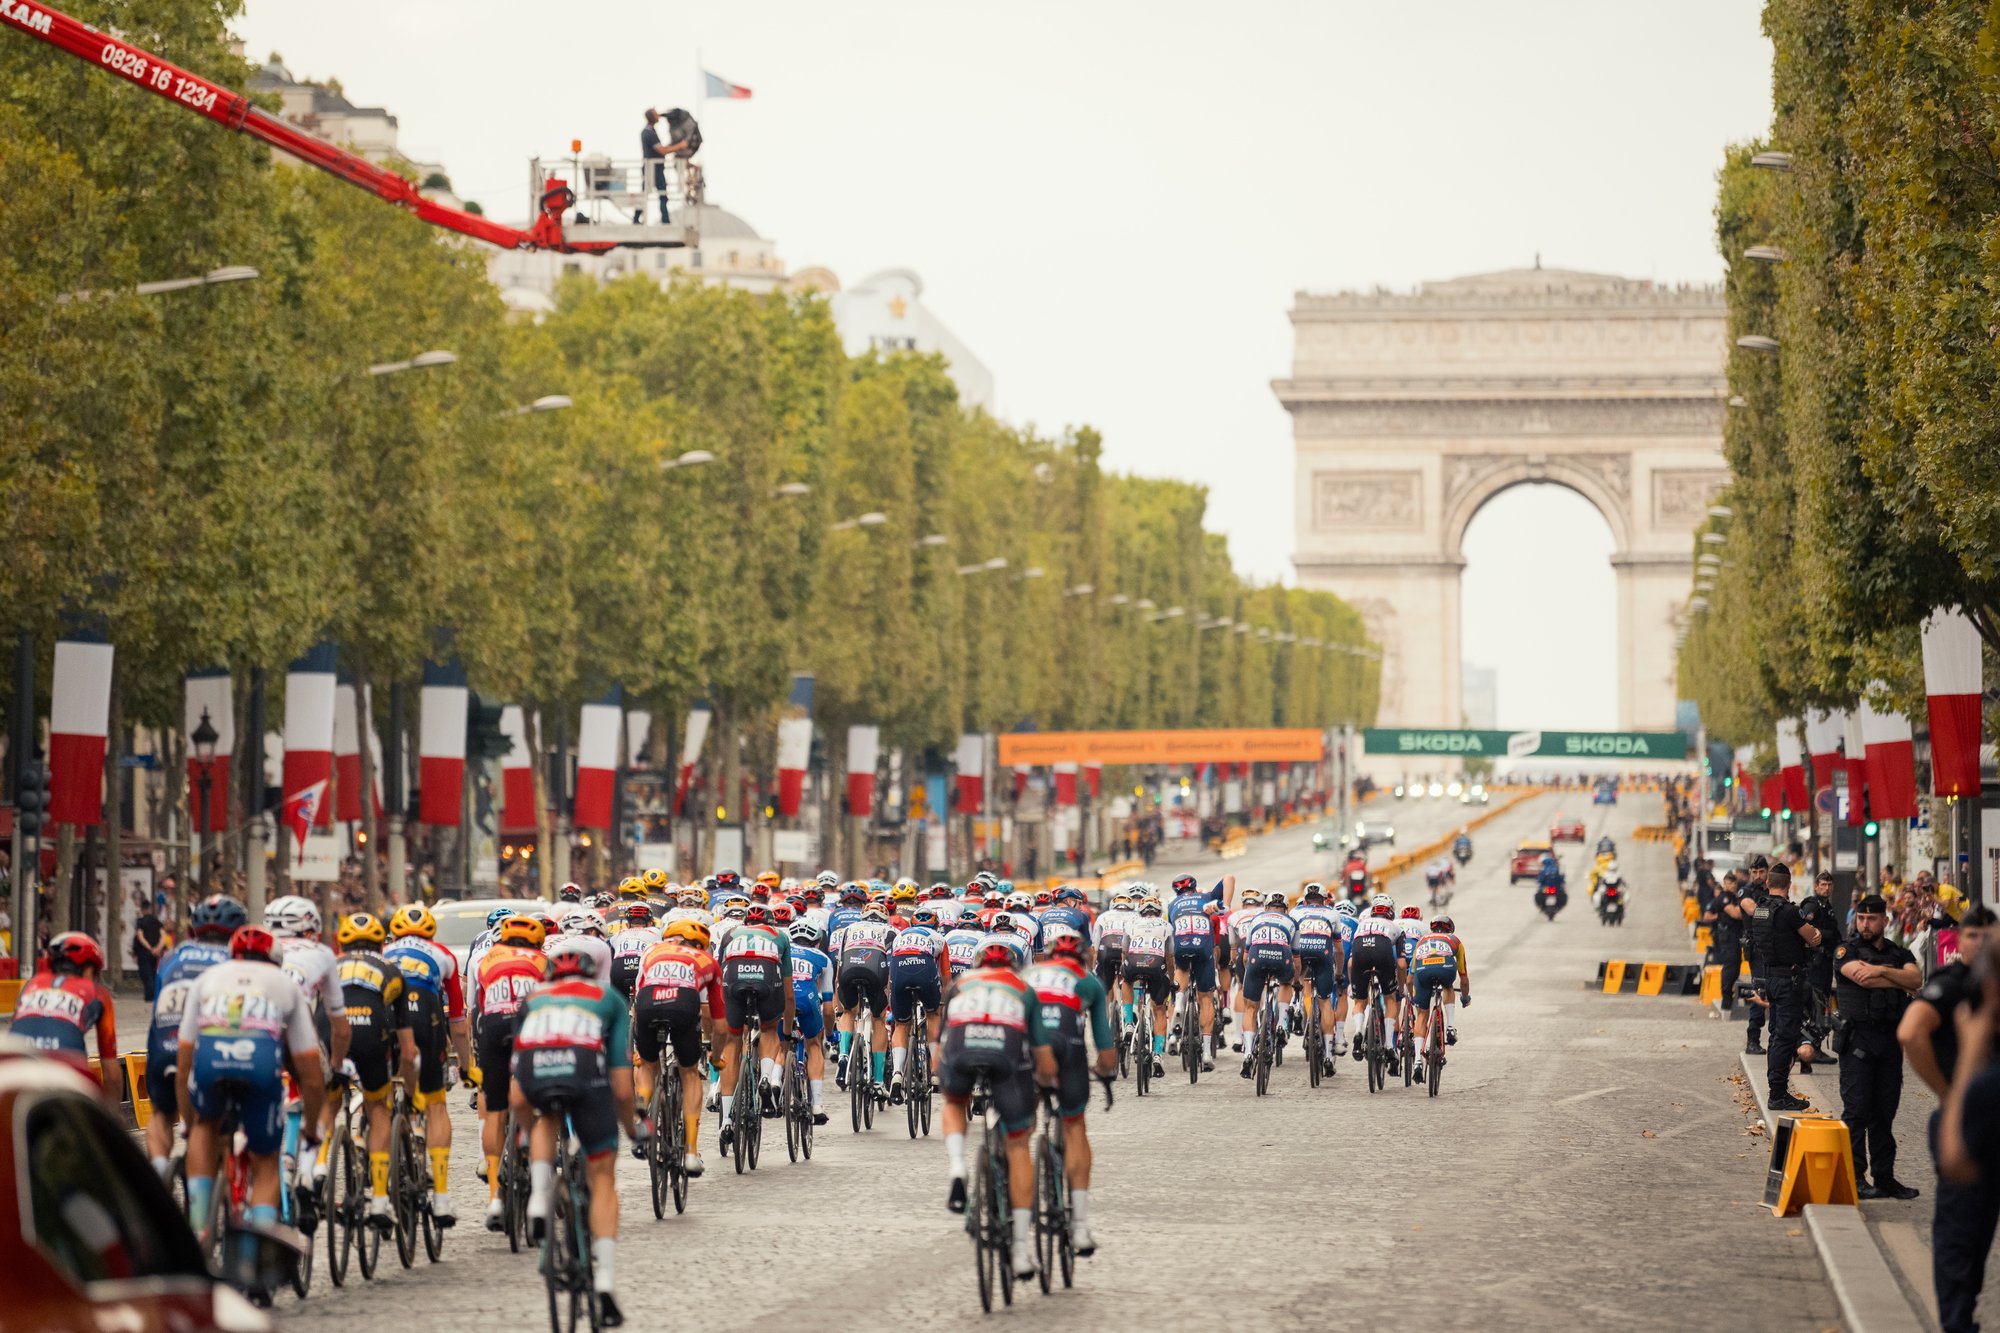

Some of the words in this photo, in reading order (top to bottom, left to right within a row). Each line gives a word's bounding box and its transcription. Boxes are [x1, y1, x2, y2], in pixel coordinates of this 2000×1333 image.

[101, 43, 148, 80] 0826
[150, 66, 173, 91] 16
[175, 78, 219, 112] 1234
[1178, 919, 1188, 930] 33
[1195, 919, 1208, 930] 33
[1131, 938, 1144, 948] 62
[1151, 938, 1163, 949] 62
[1258, 949, 1283, 957] RENSON
[623, 957, 640, 966] UAE
[792, 959, 812, 974] 161
[898, 957, 926, 967] FANTINI
[737, 964, 765, 974] BORA
[655, 988, 680, 1001] MOT
[964, 1024, 1006, 1040] BORA
[532, 1049, 577, 1067] BORA
